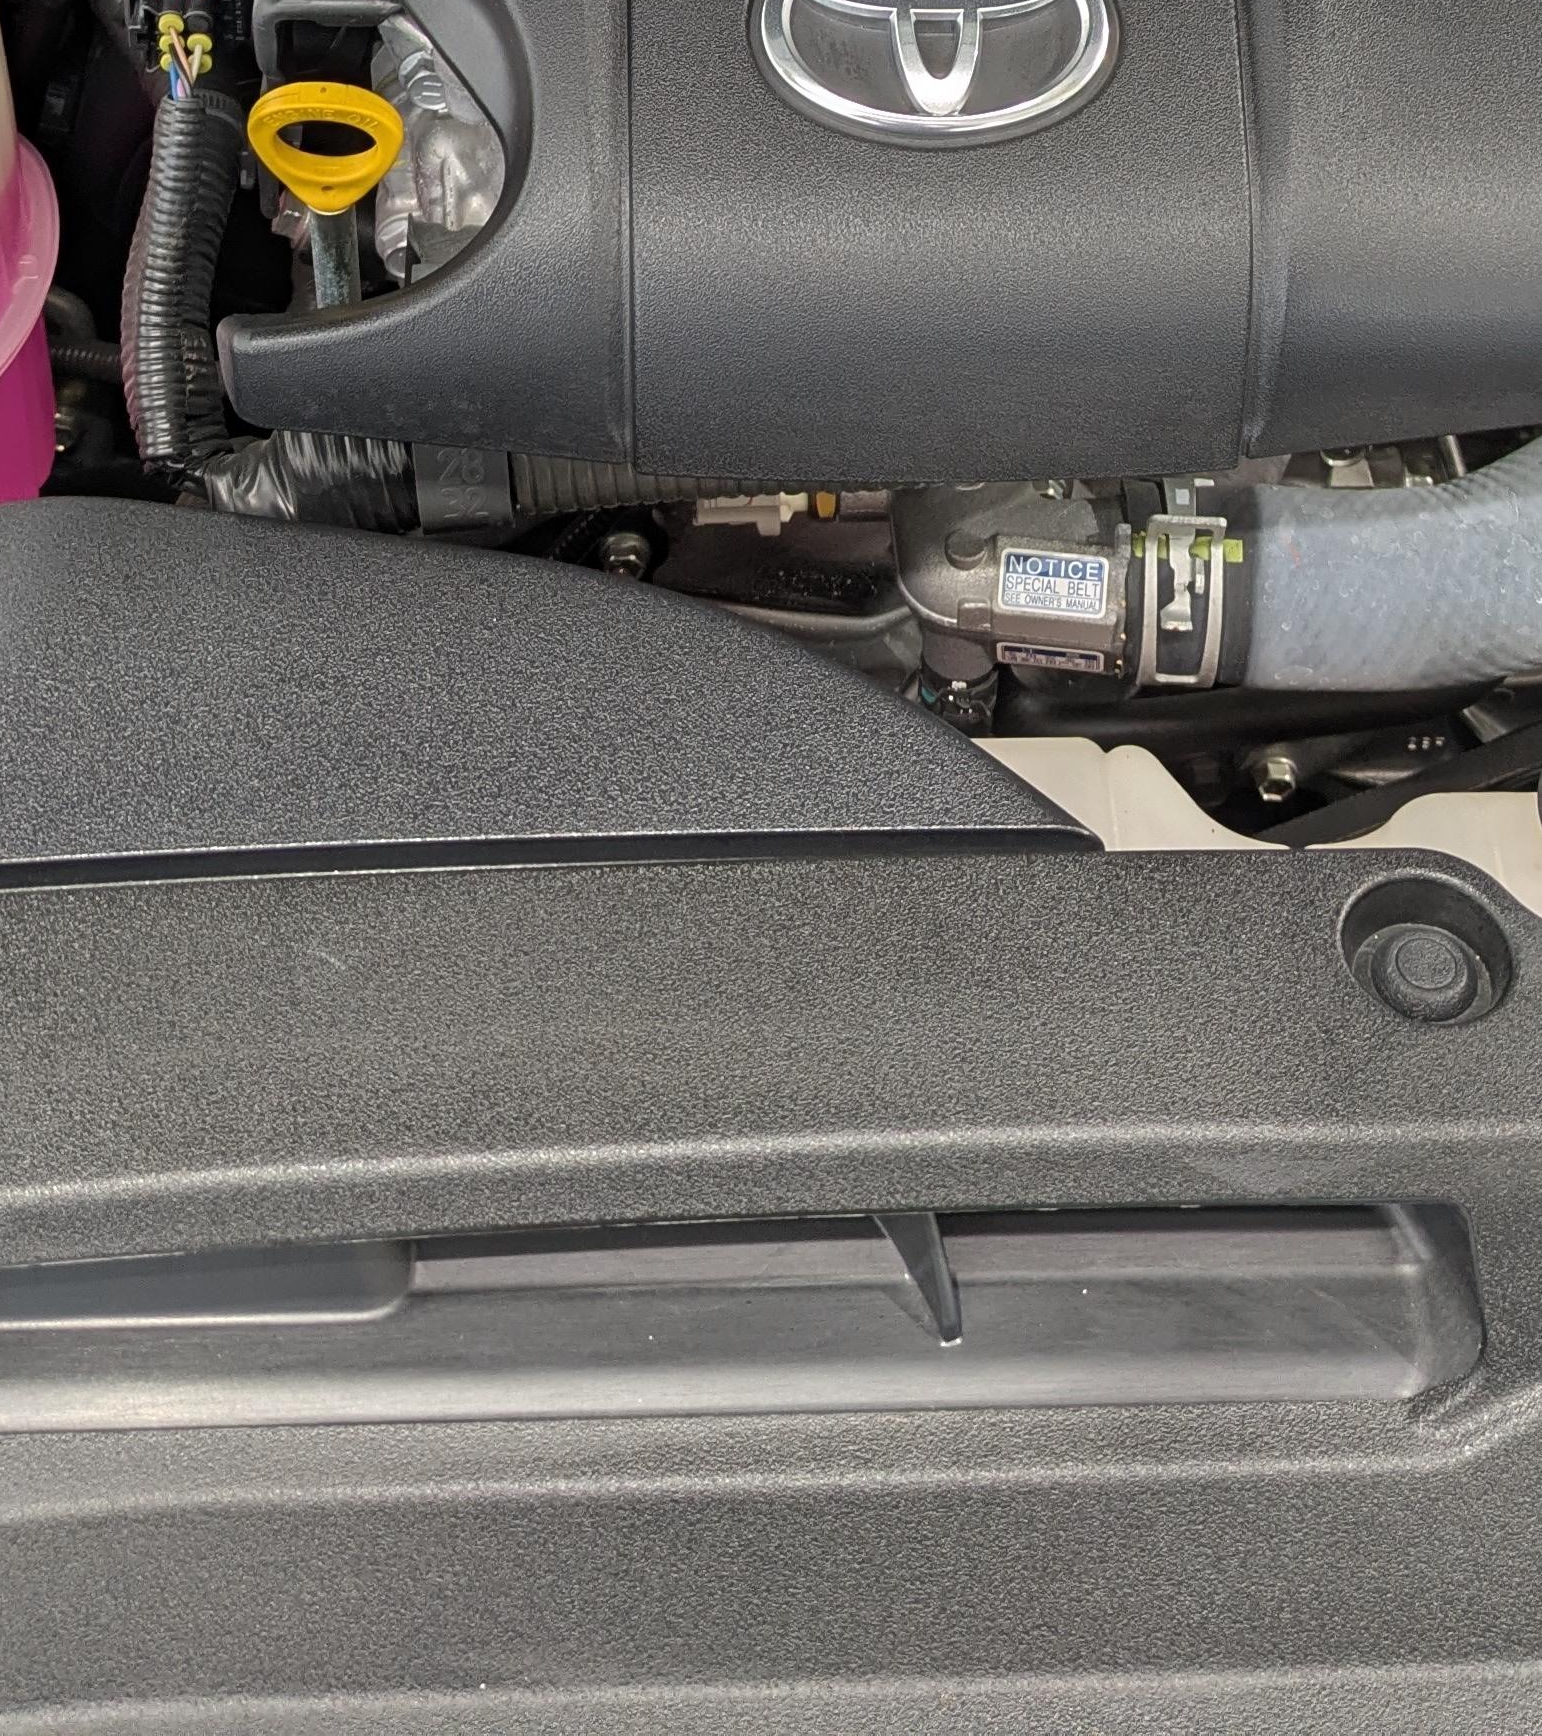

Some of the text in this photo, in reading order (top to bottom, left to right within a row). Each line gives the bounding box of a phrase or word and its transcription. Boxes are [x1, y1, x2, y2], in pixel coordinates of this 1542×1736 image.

[1009, 555, 1100, 580] NOTICE
[1006, 575, 1100, 597] SPECIAL BELT
[1005, 592, 1099, 610] SEE OWNER'S MANUAL
